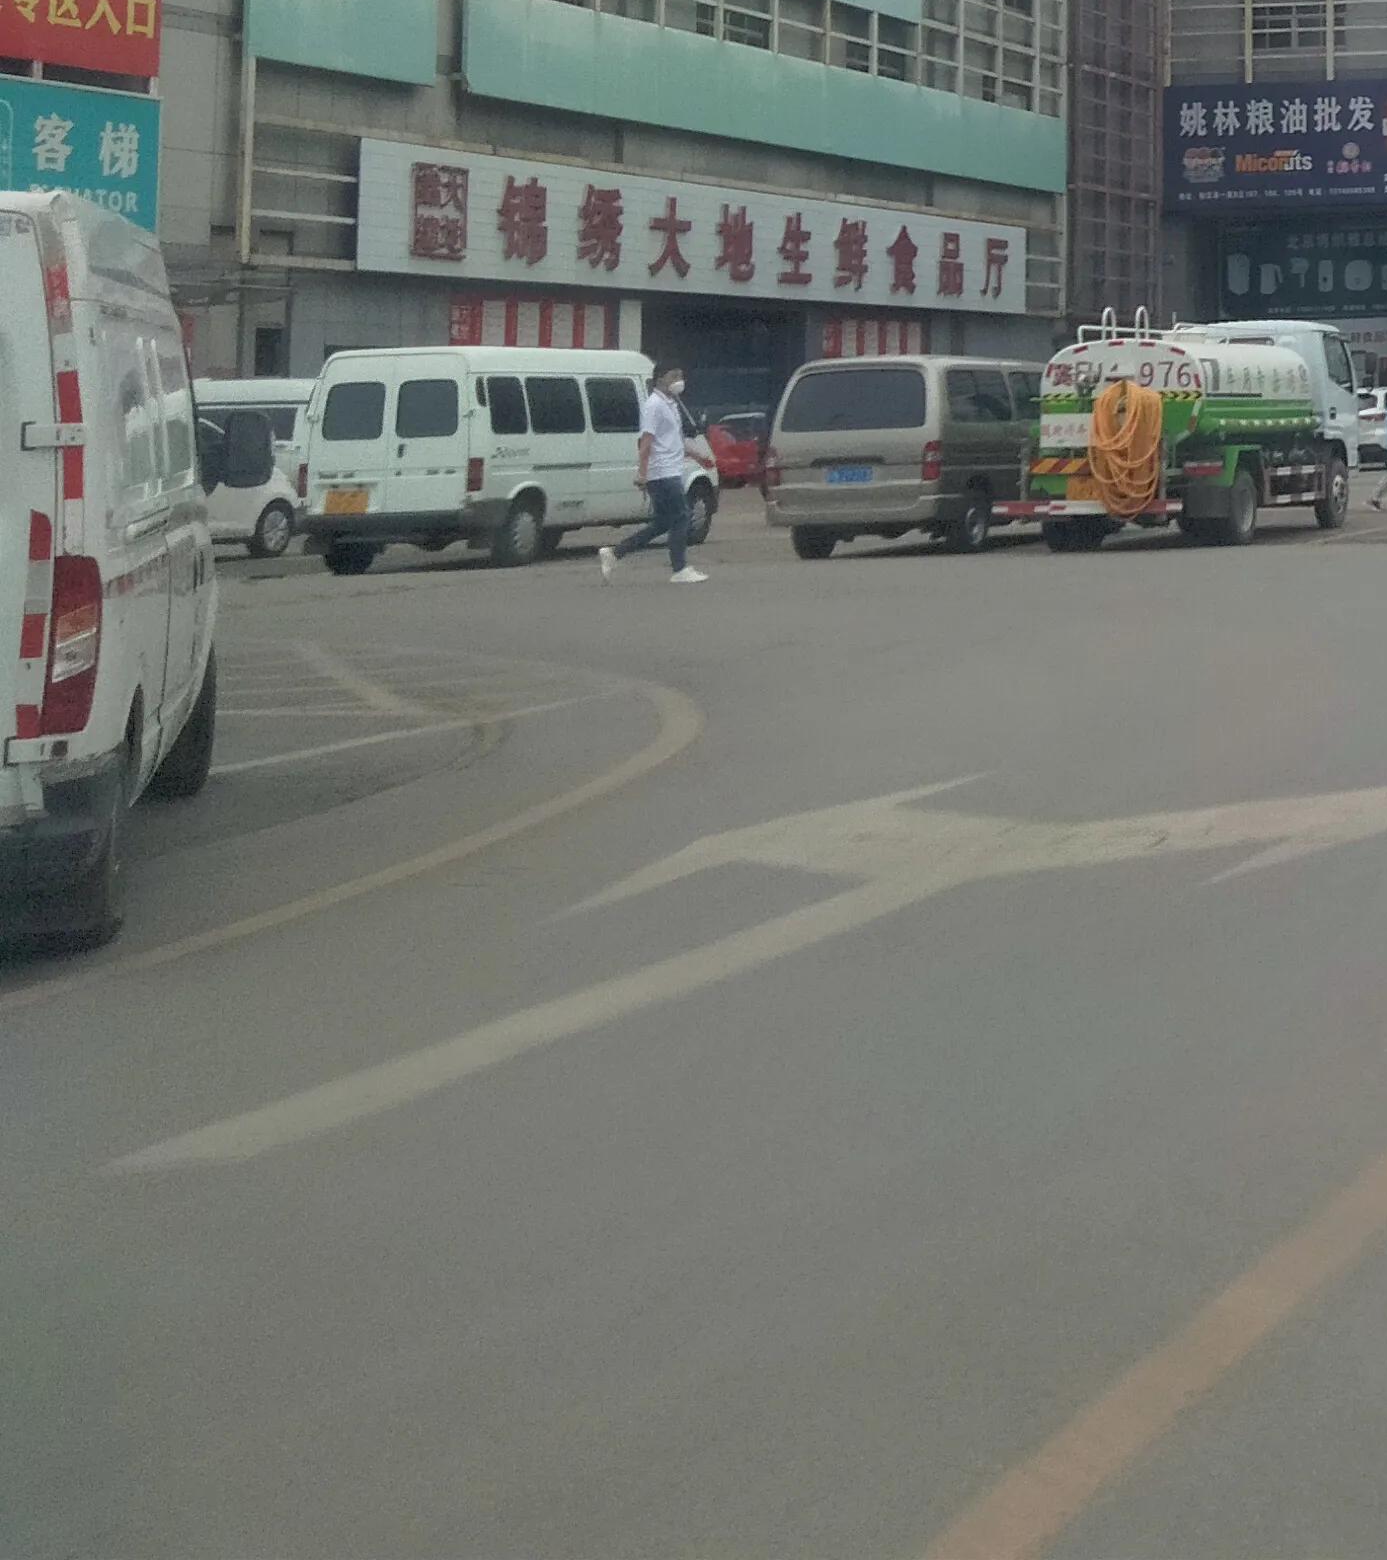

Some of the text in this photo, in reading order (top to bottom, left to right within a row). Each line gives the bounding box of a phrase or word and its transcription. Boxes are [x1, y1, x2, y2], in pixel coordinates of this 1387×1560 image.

[32, 112, 140, 178] 客梯
[1179, 96, 1375, 137] 姚林粮油批发
[497, 174, 1009, 298] 锦绣大地生鲜食品厅
